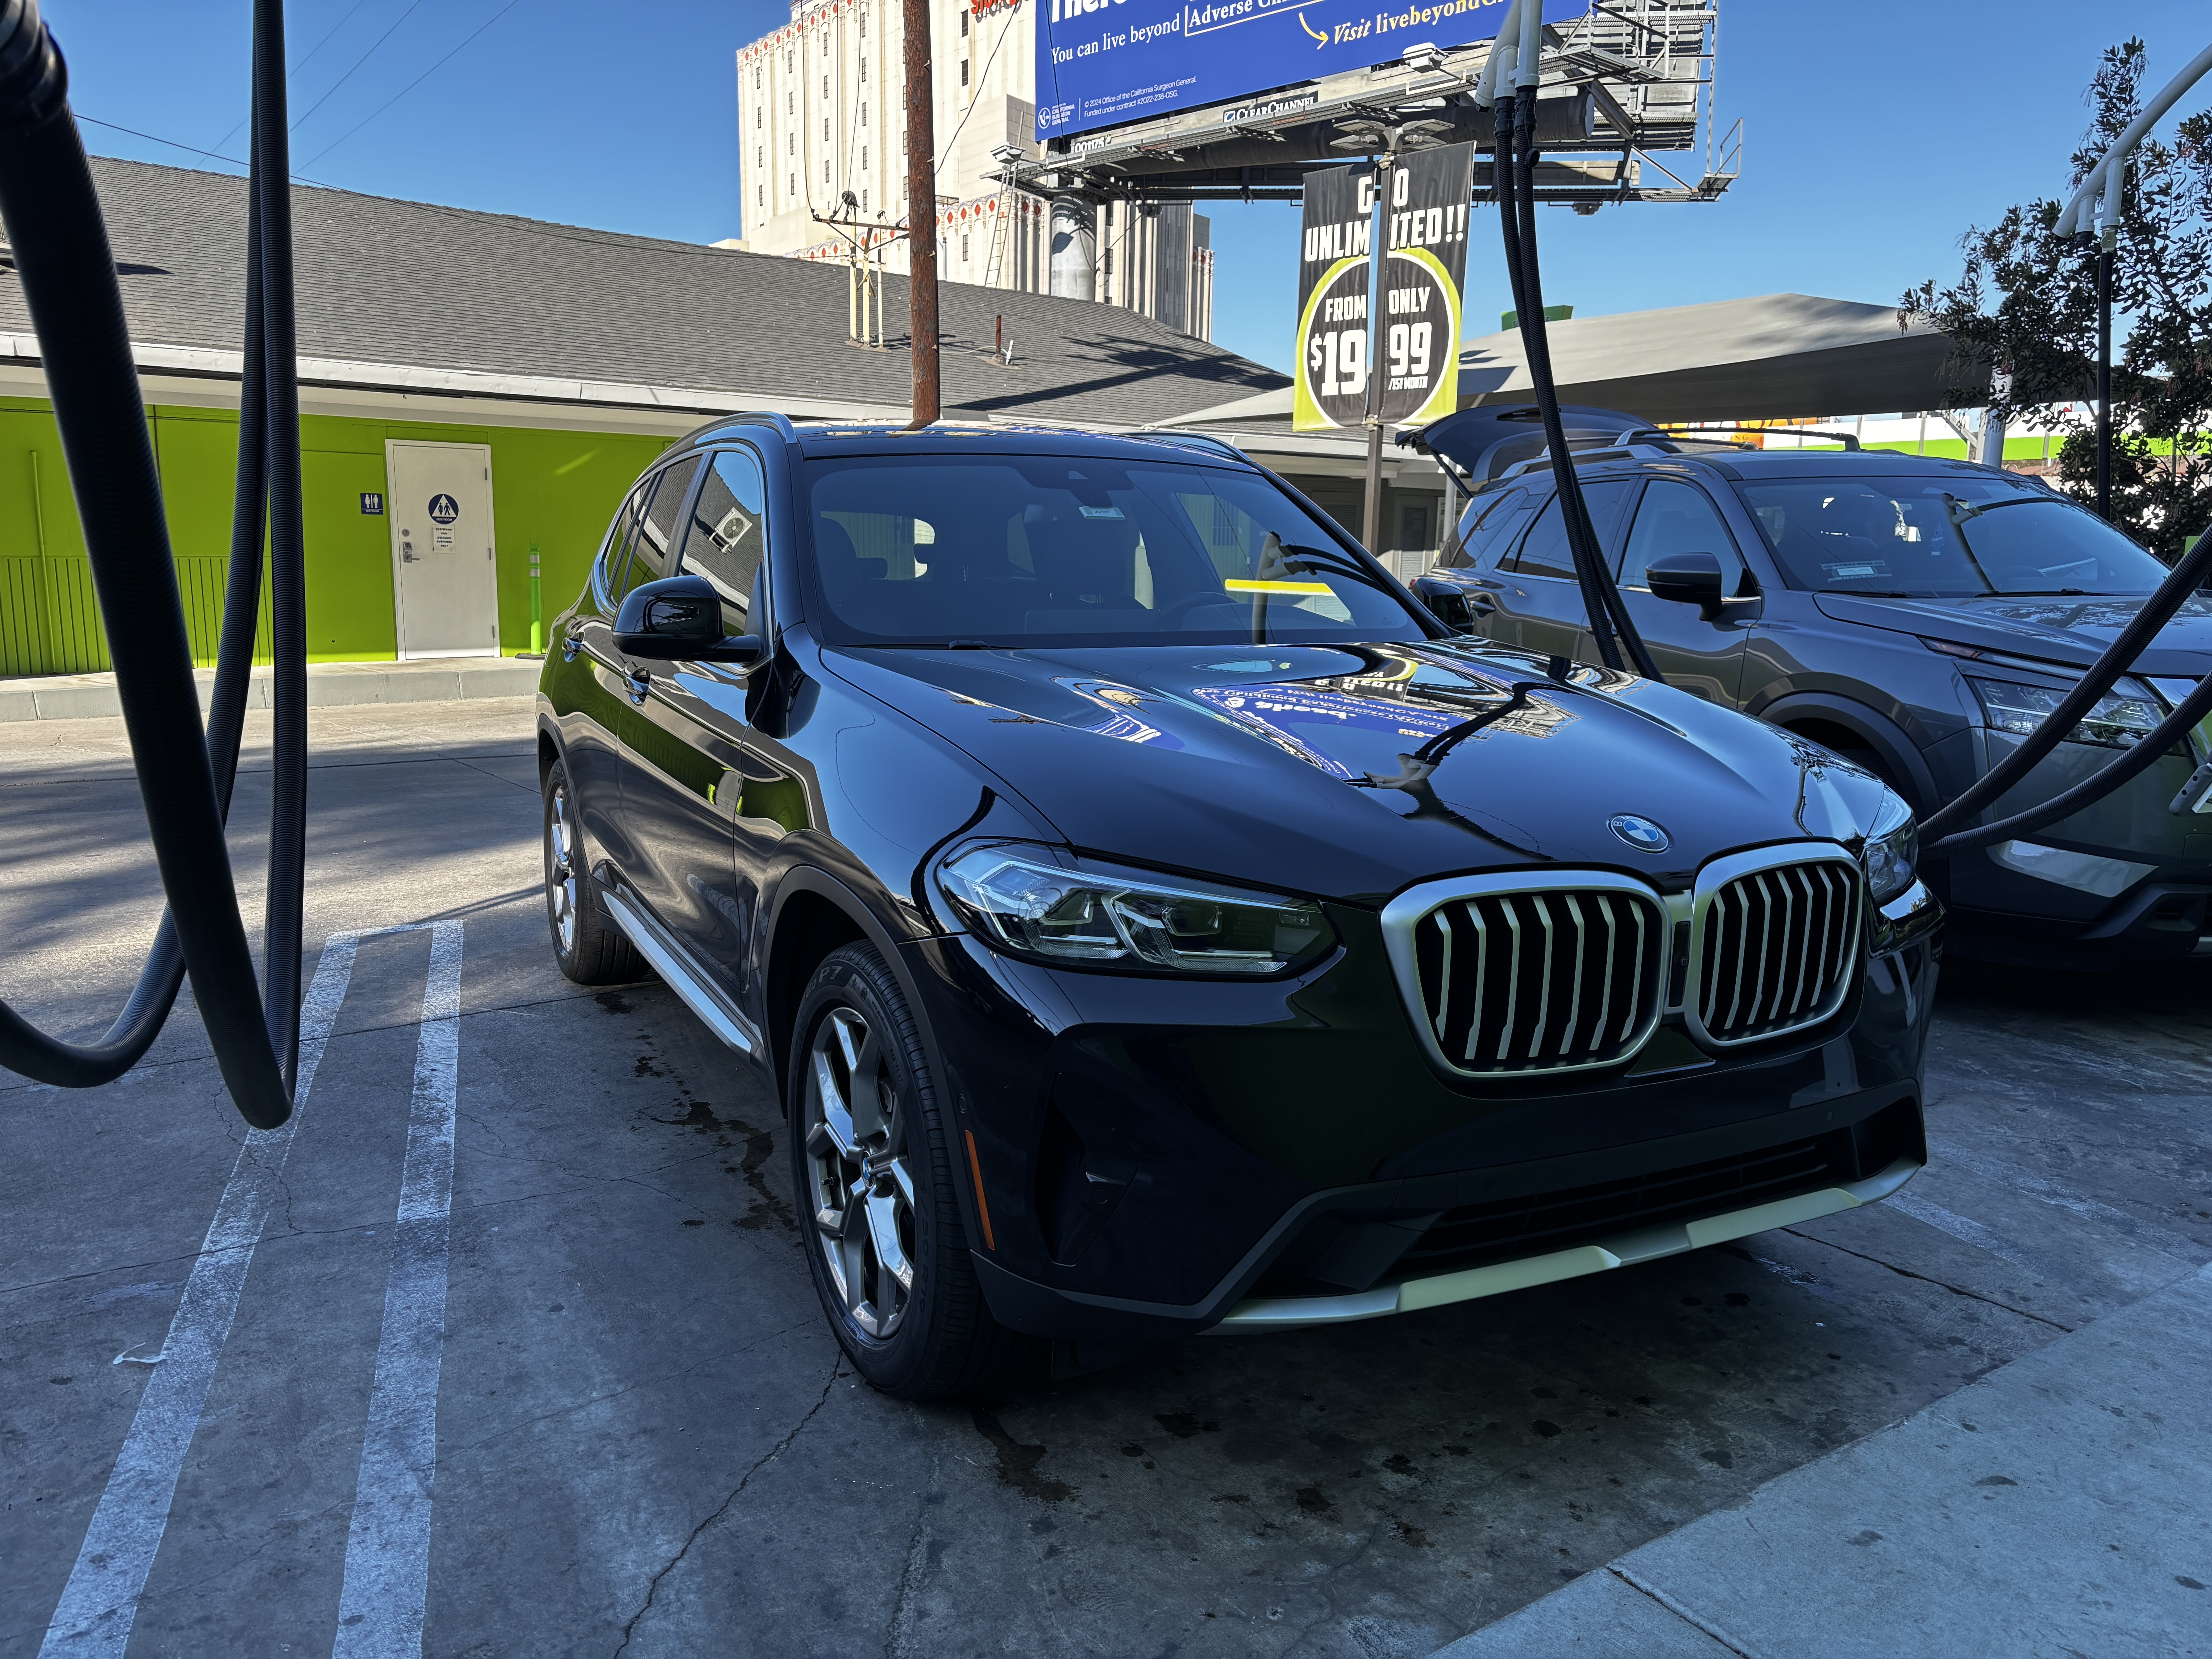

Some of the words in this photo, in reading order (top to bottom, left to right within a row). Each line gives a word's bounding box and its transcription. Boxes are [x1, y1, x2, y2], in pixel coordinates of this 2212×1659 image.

[1051, 47, 1073, 64] You
[1077, 41, 1098, 57] can
[1103, 33, 1126, 50] live
[1130, 13, 1180, 43] beyond
[1188, 0, 1253, 27] Adverse
[1334, 19, 1371, 45] Visit
[1089, 98, 1101, 107] 2024
[1102, 96, 1116, 104] Office
[1131, 87, 1153, 97] California
[1154, 82, 1175, 91] Surgeon
[1176, 76, 1197, 86] General.
[1084, 108, 1102, 117] Funded
[1102, 106, 1116, 114] under
[1116, 100, 1137, 111] contract
[1325, 294, 1367, 322] FROM
[1388, 287, 1431, 315] ONLY
[1310, 329, 1367, 397] $19
[1389, 322, 1432, 376] 99
[819, 965, 843, 983] P7
